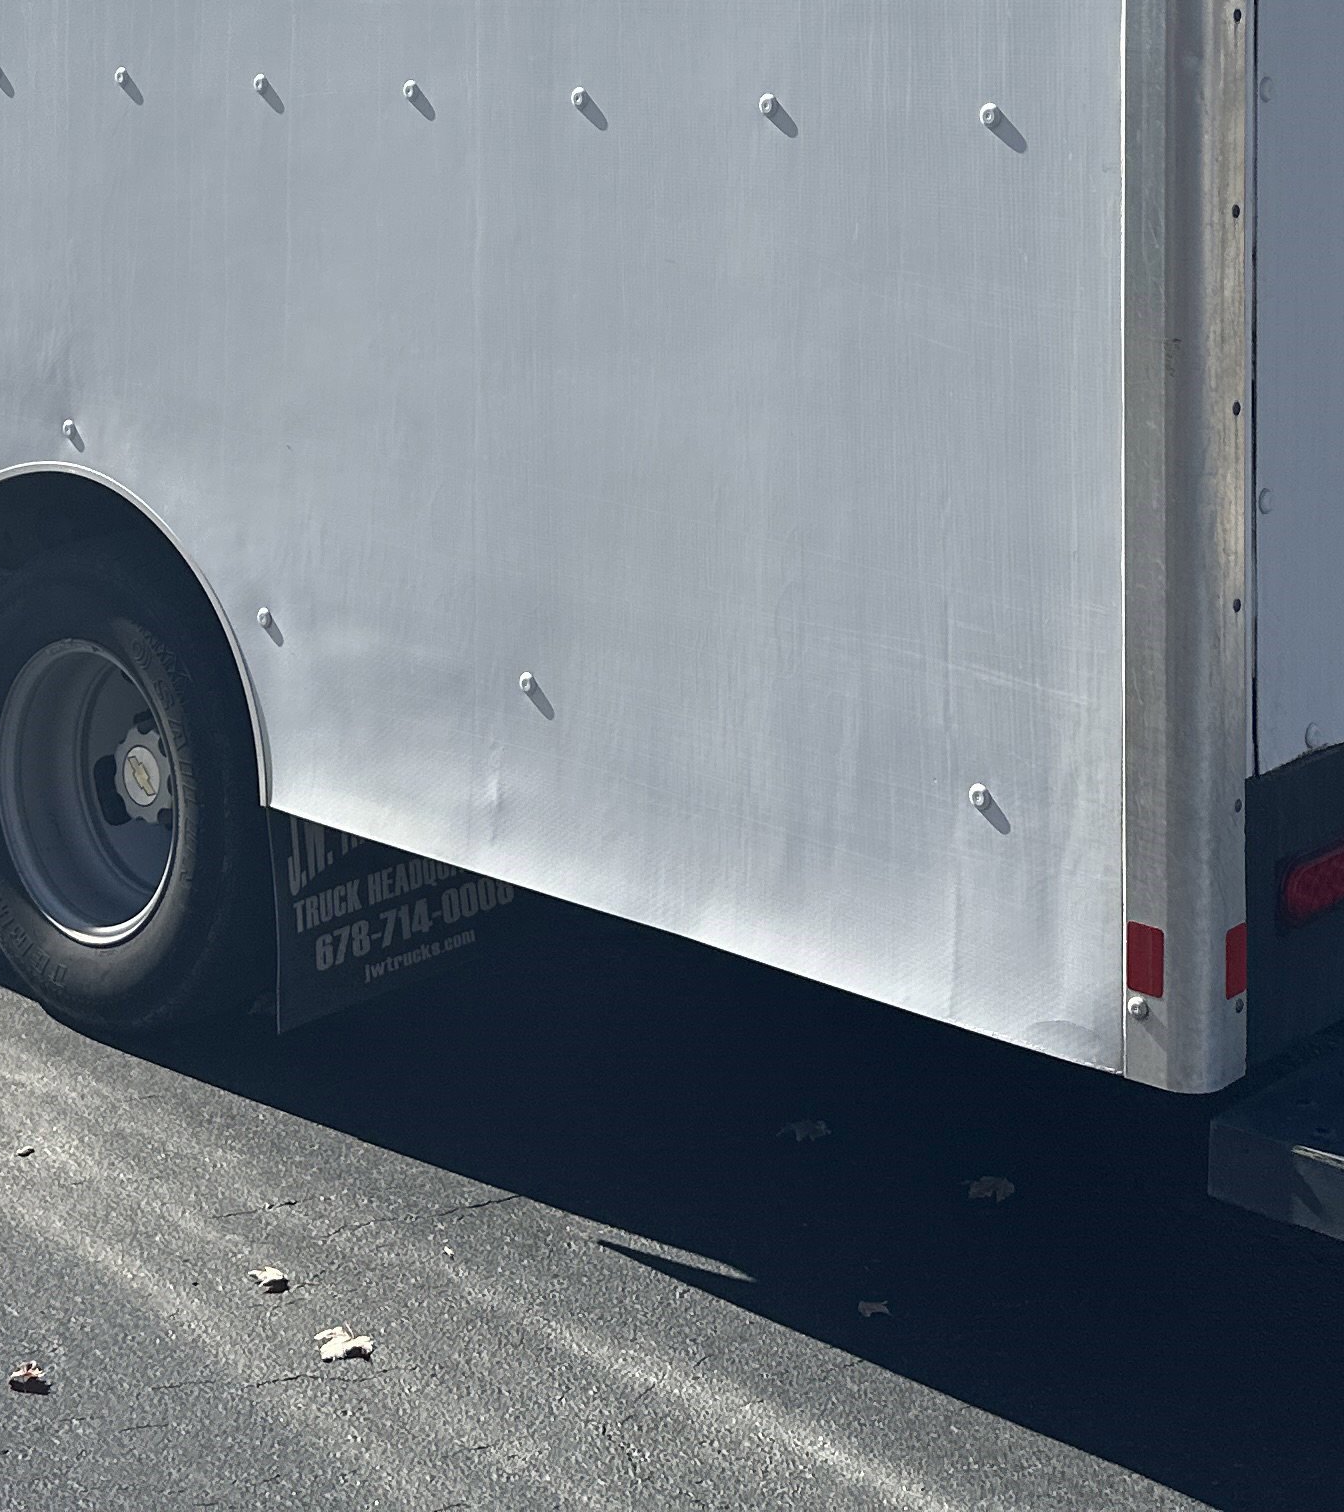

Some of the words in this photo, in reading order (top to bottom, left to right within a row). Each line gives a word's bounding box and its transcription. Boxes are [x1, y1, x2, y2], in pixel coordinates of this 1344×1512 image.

[293, 879, 362, 933] TRUCK
[367, 857, 464, 906] HEADQU
[364, 928, 476, 983] jwtrucks.com
